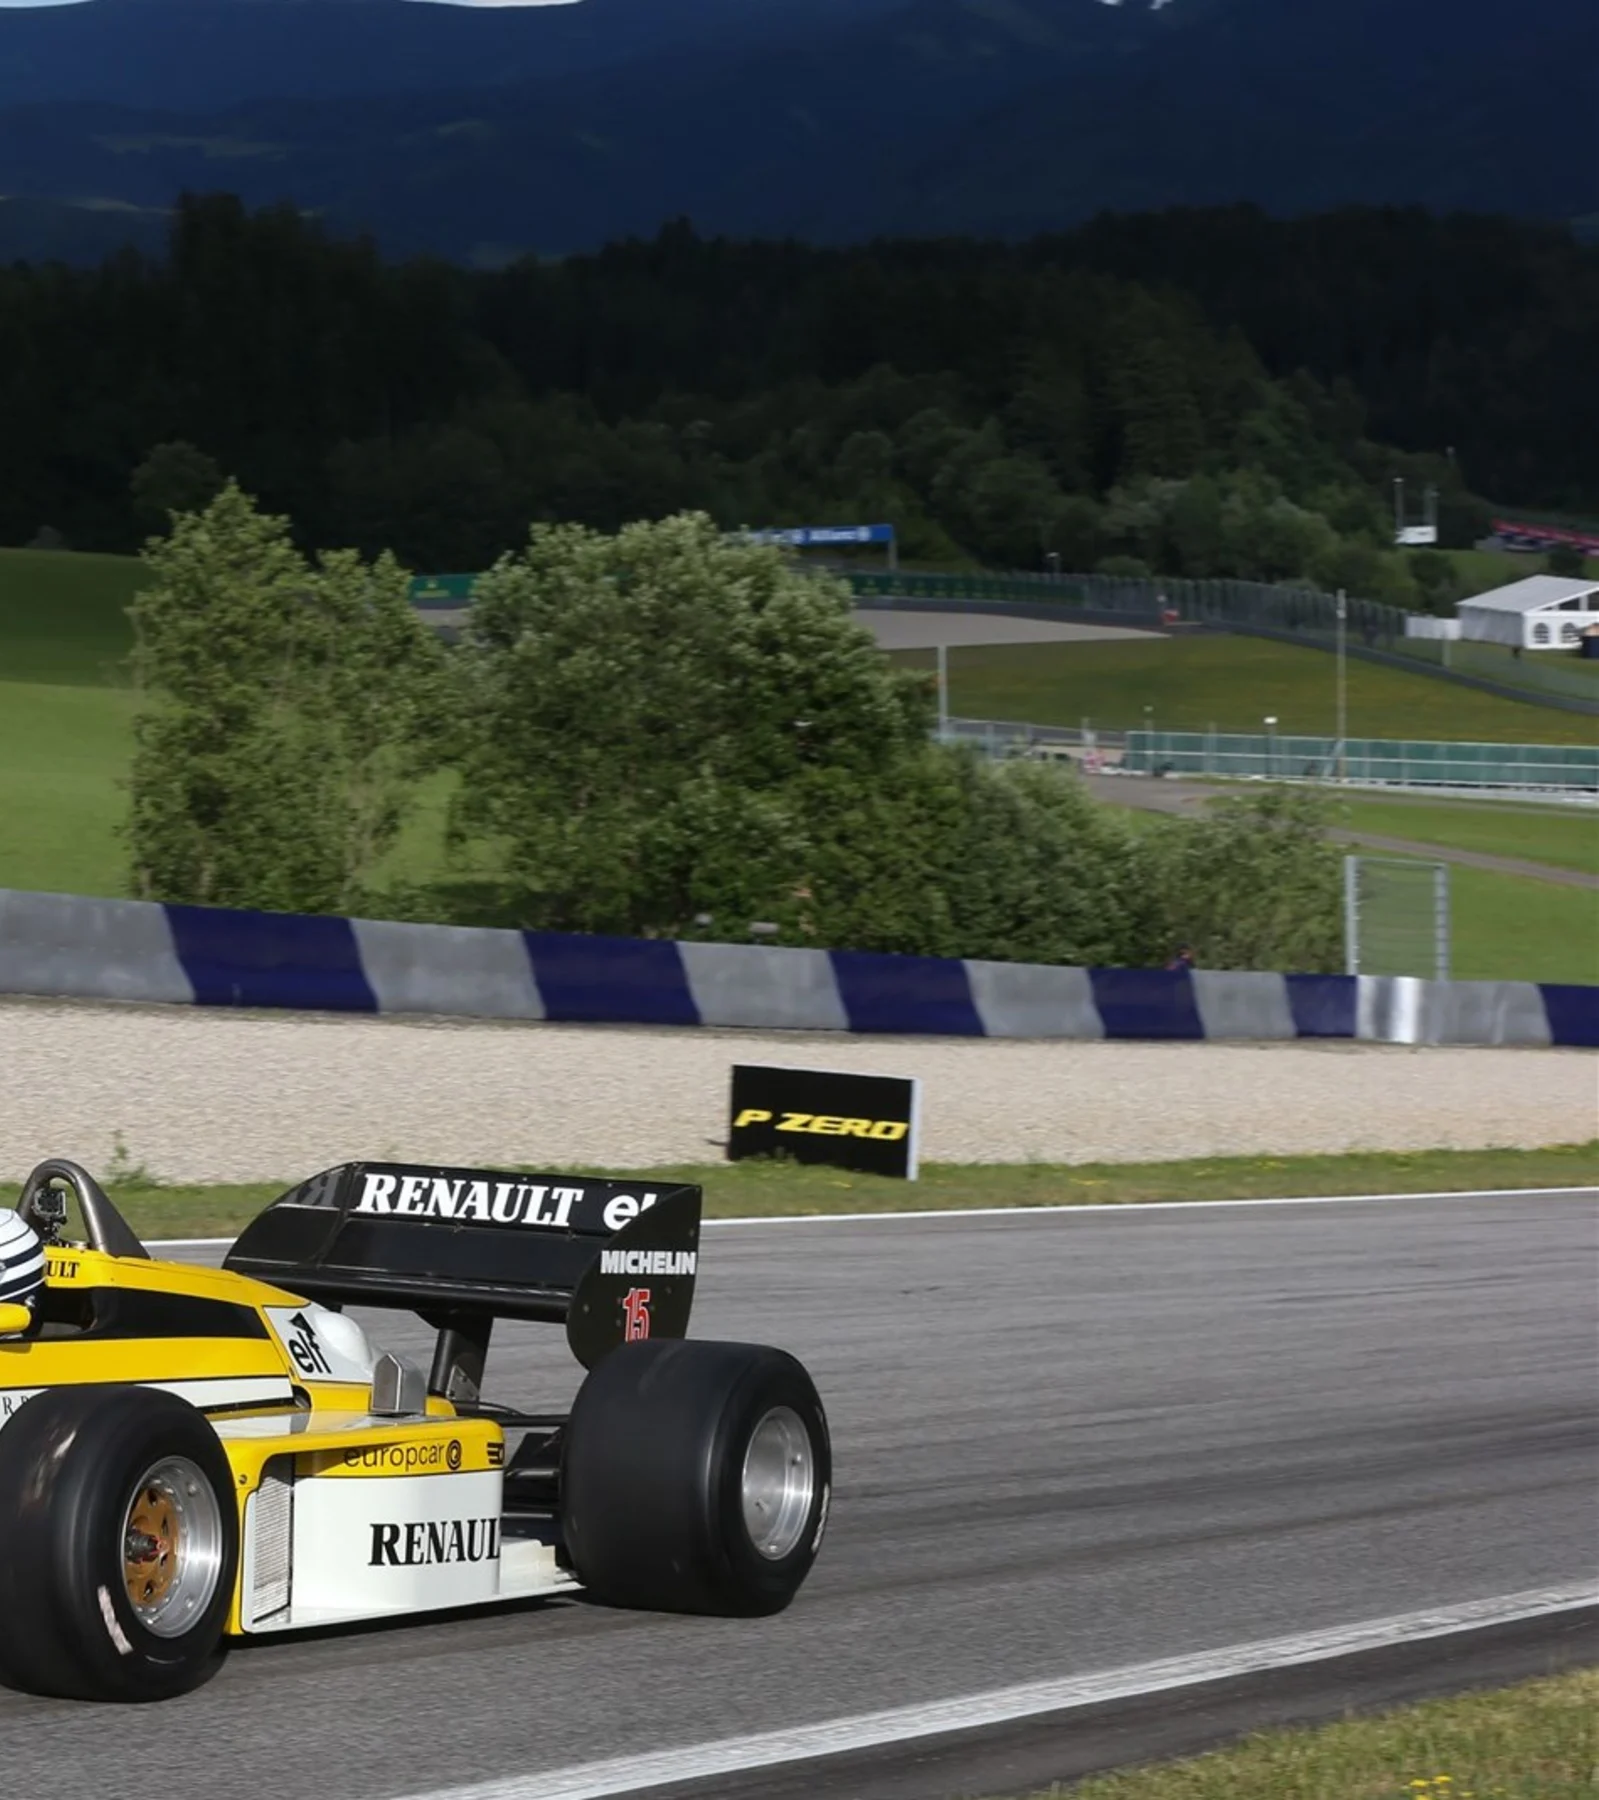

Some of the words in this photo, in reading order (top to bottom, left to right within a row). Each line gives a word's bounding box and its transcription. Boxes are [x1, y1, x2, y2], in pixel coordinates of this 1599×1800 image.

[733, 1109, 773, 1127] P
[774, 1112, 910, 1140] ZERO
[355, 1173, 584, 1227] RENAULT
[46, 1260, 80, 1278] ULT
[600, 1250, 697, 1275] MICHELIN
[622, 1287, 651, 1343] 15
[288, 1330, 332, 1374] elf
[343, 1442, 446, 1472] europcar
[368, 1518, 499, 1566] RENAUL
